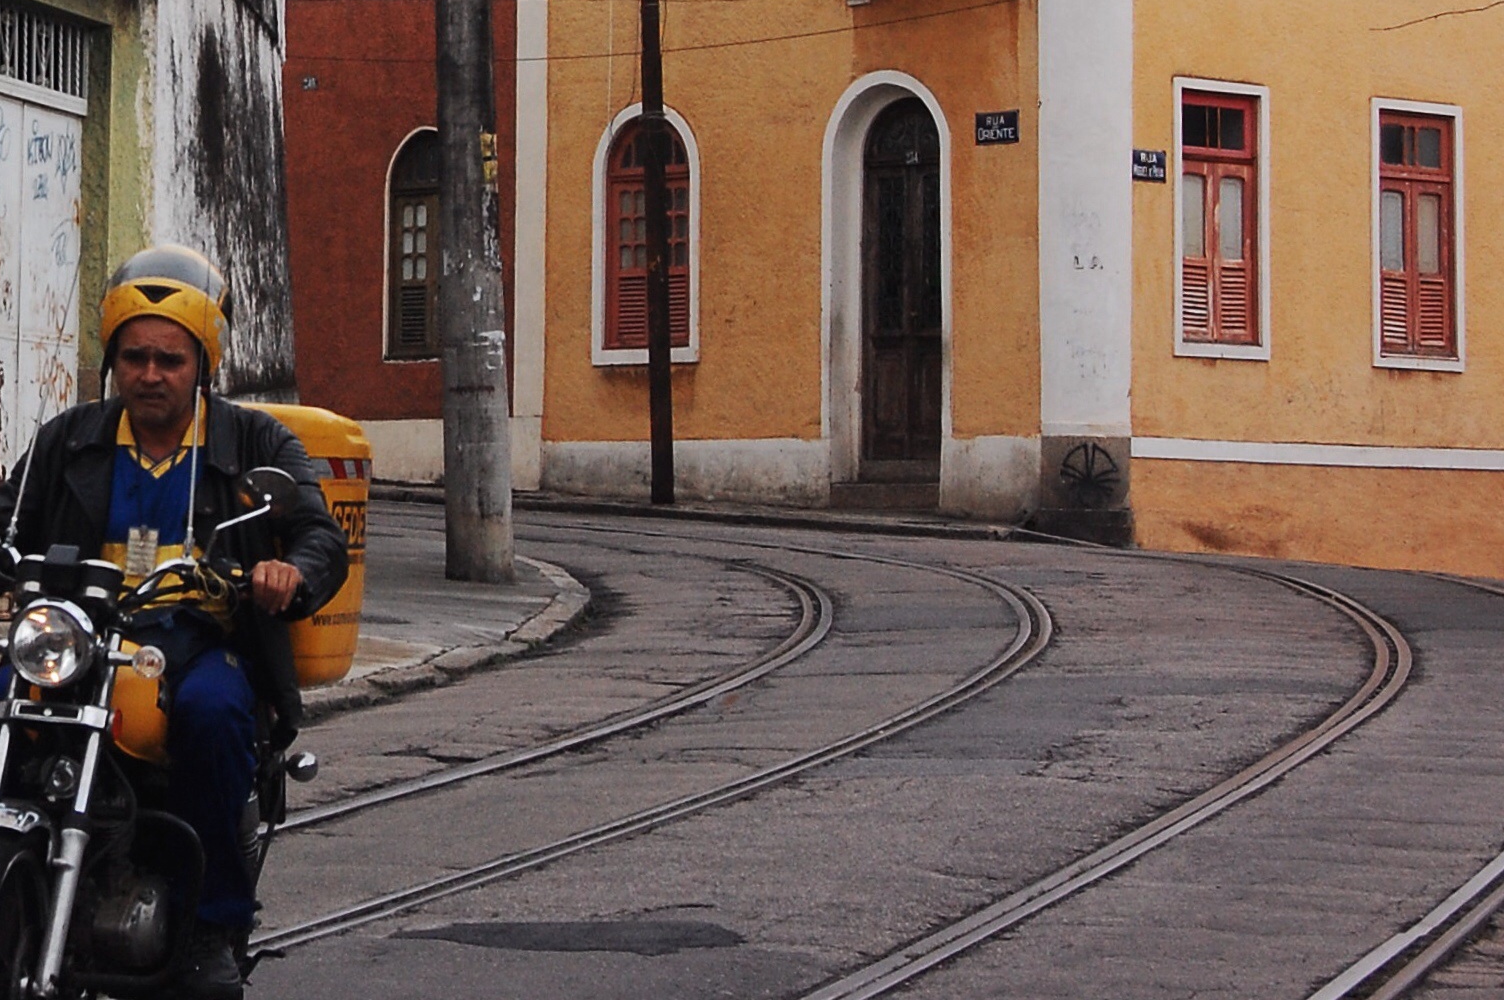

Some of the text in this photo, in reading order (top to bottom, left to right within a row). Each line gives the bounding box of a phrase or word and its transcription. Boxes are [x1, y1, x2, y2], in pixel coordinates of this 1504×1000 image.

[986, 115, 1005, 126] RUA
[977, 127, 1015, 140] ORIENTE
[1140, 152, 1158, 163] RUA
